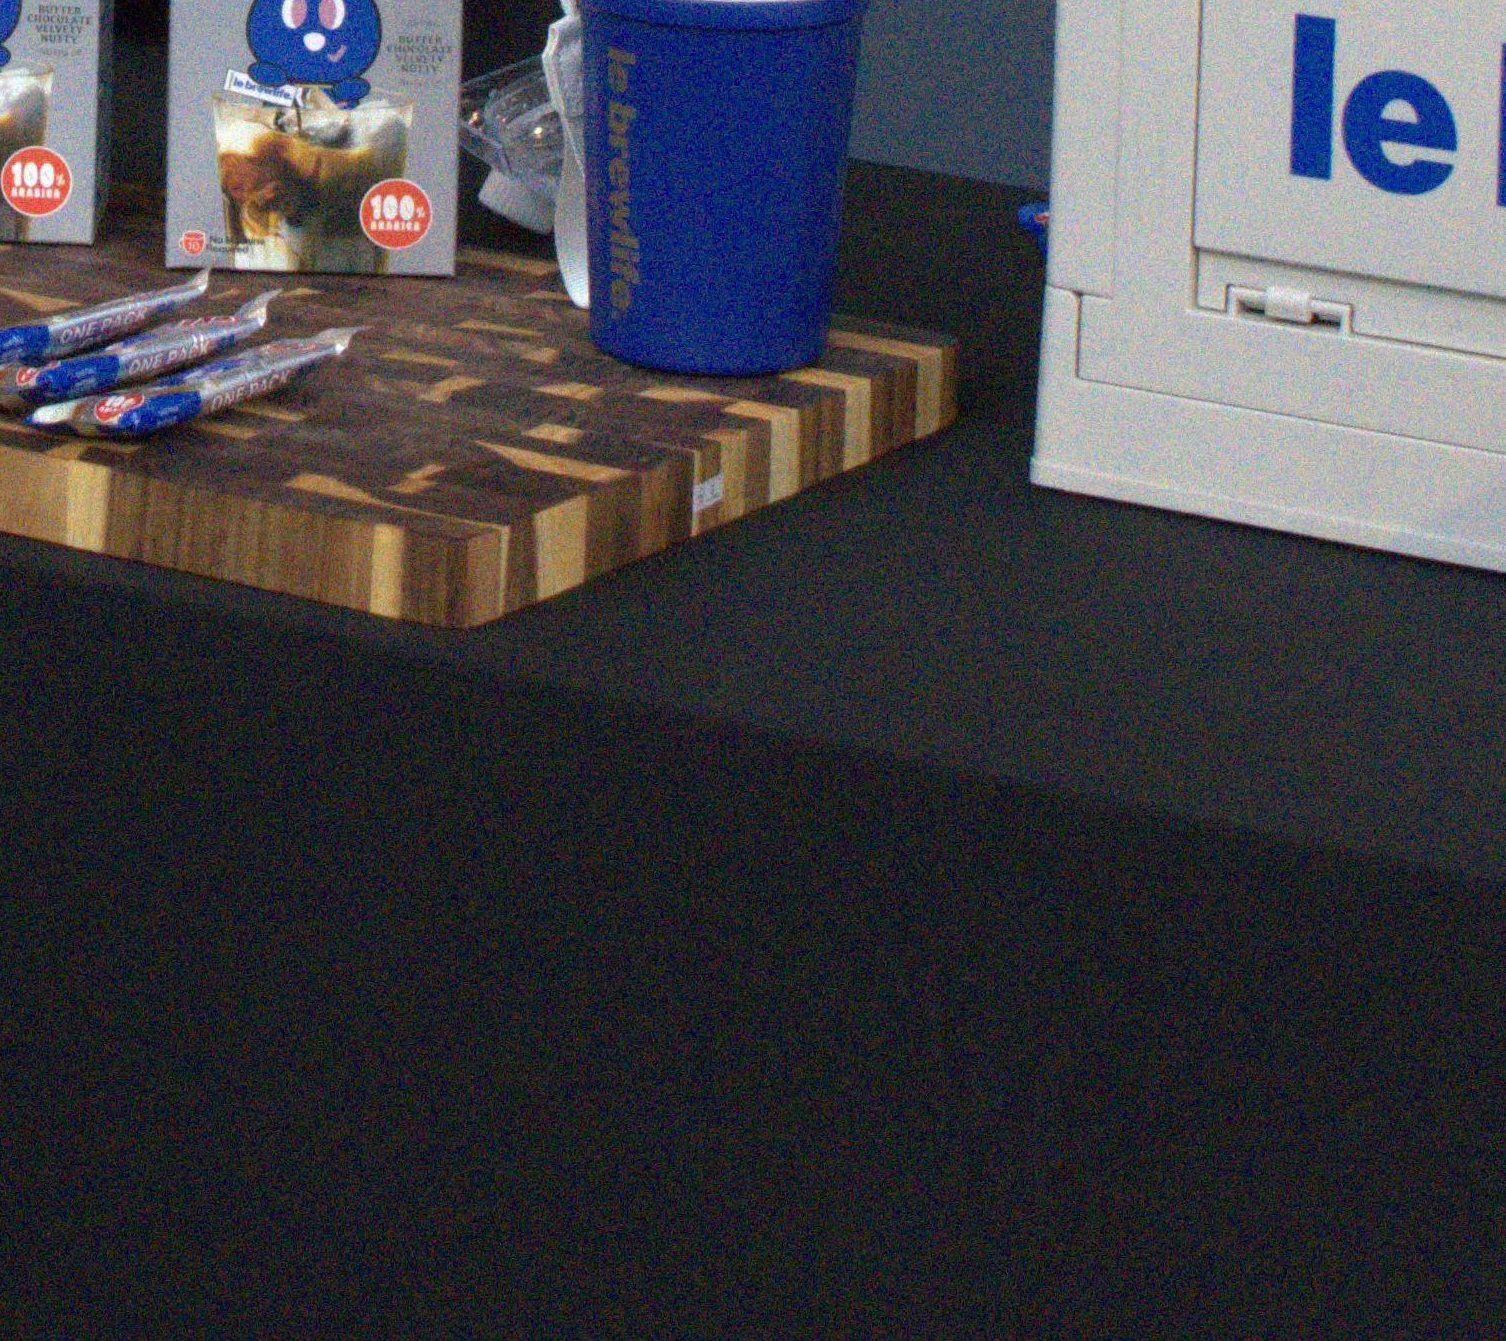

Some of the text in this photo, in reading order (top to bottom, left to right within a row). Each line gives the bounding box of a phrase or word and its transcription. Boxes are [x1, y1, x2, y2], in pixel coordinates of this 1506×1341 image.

[27, 14, 91, 25] CHOCOLATE
[608, 46, 635, 92] le
[1289, 14, 1458, 196] le
[11, 162, 66, 188] 100%
[370, 195, 425, 221] 100%
[60, 320, 96, 344] ONE
[128, 353, 162, 375] ONE
[211, 388, 245, 413] ONE
